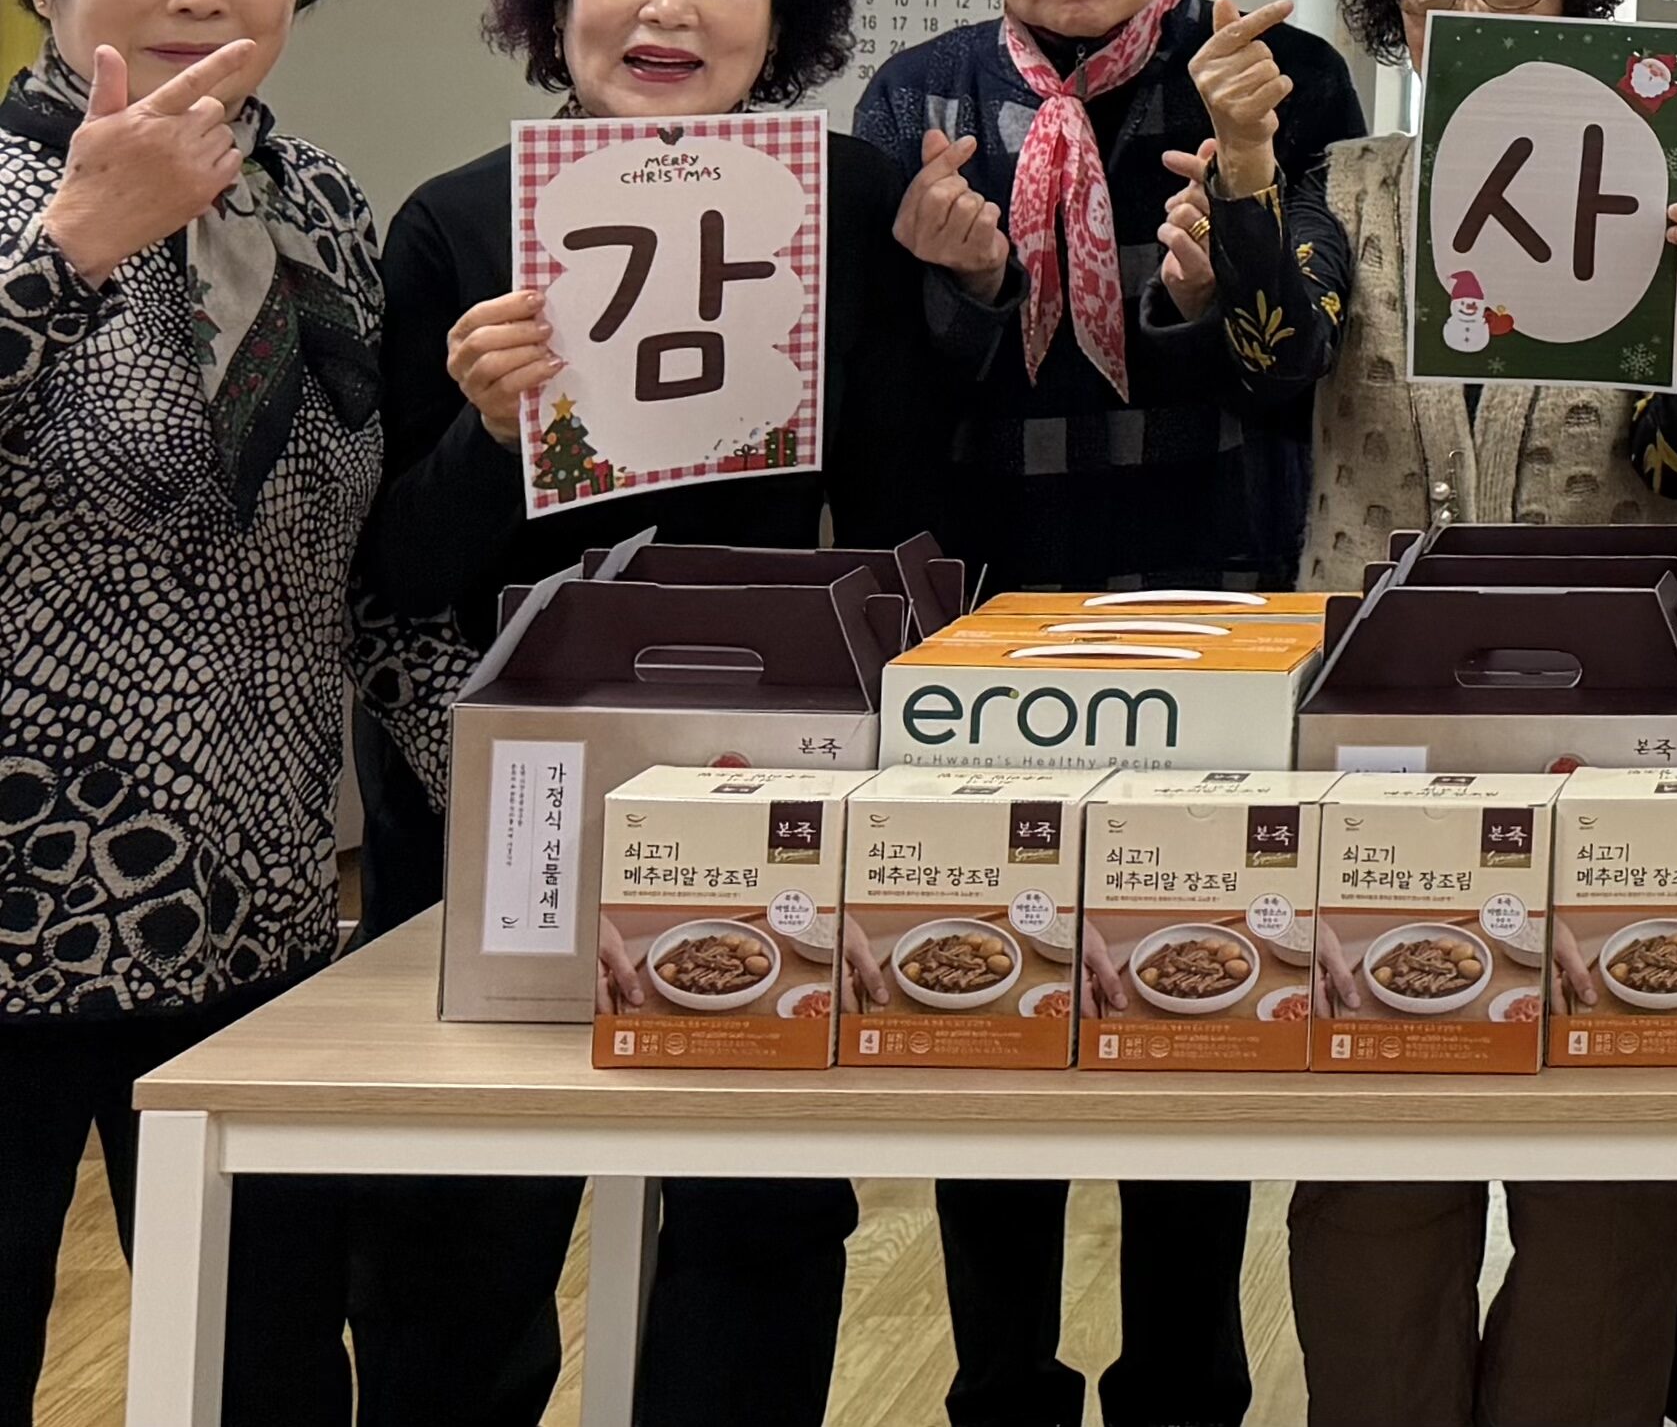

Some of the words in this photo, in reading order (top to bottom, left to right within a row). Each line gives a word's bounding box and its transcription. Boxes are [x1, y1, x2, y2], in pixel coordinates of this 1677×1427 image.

[862, 15, 877, 30] 16
[892, 16, 907, 30] 17
[923, 17, 938, 32] 18
[860, 39, 875, 54] 23
[644, 153, 700, 169] MERRY
[620, 166, 722, 185] CHRISTMAS
[1452, 123, 1640, 282] 사
[562, 209, 777, 402] 감
[902, 684, 1178, 747] erom
[798, 738, 842, 760] 본죽
[1634, 739, 1676, 761] 본죽
[1023, 754, 1096, 770] Healthy
[1108, 757, 1173, 771] Recipe
[545, 763, 566, 830] 가정식
[777, 822, 816, 842] 본죽
[1017, 822, 1055, 842] 본죽
[1254, 826, 1293, 845] 본죽
[1489, 826, 1527, 846] 본죽
[625, 842, 679, 861] 쇠고기
[869, 841, 921, 861] 쇠고기
[1107, 847, 1159, 866] 쇠고기
[1343, 845, 1395, 864] 쇠고기
[1577, 843, 1629, 862] 쇠고기
[538, 839, 561, 928] 선물세트
[624, 866, 698, 886] 메추리알
[704, 867, 758, 887] 장조림
[869, 866, 941, 886] 메추리알
[947, 867, 999, 887] 장조림
[1107, 871, 1178, 891] 메추리알
[1184, 872, 1237, 891] 장조림
[1342, 869, 1413, 889] 메추리알
[1419, 871, 1471, 891] 장조림
[1577, 867, 1647, 886] 메추리알
